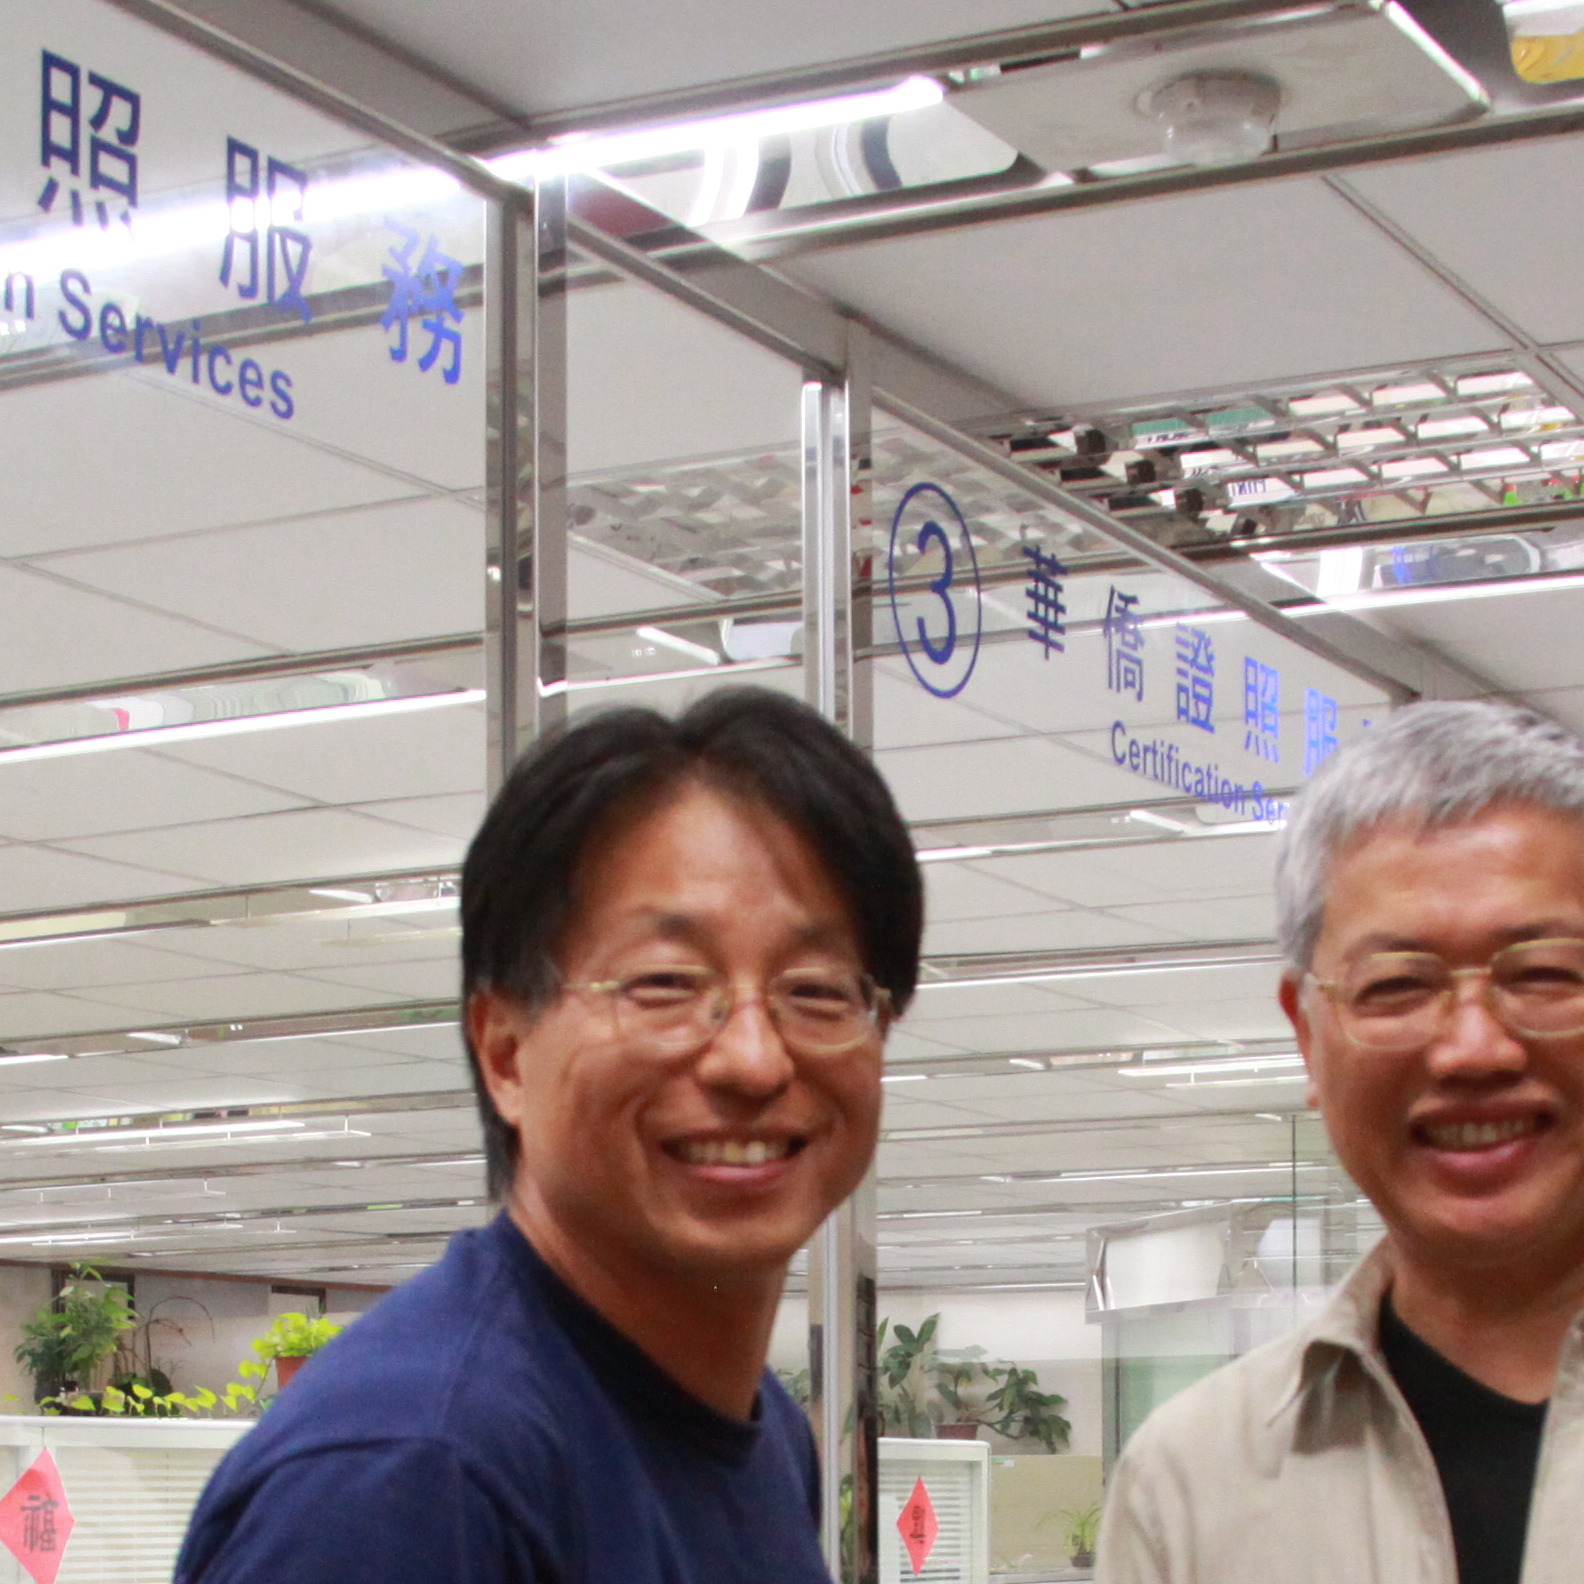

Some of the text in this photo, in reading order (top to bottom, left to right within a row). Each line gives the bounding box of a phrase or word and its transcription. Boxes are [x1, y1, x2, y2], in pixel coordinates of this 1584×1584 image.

[56, 266, 296, 421] Services
[1023, 545, 1372, 777] 華僑證照服
[1111, 721, 1246, 816] Certification
